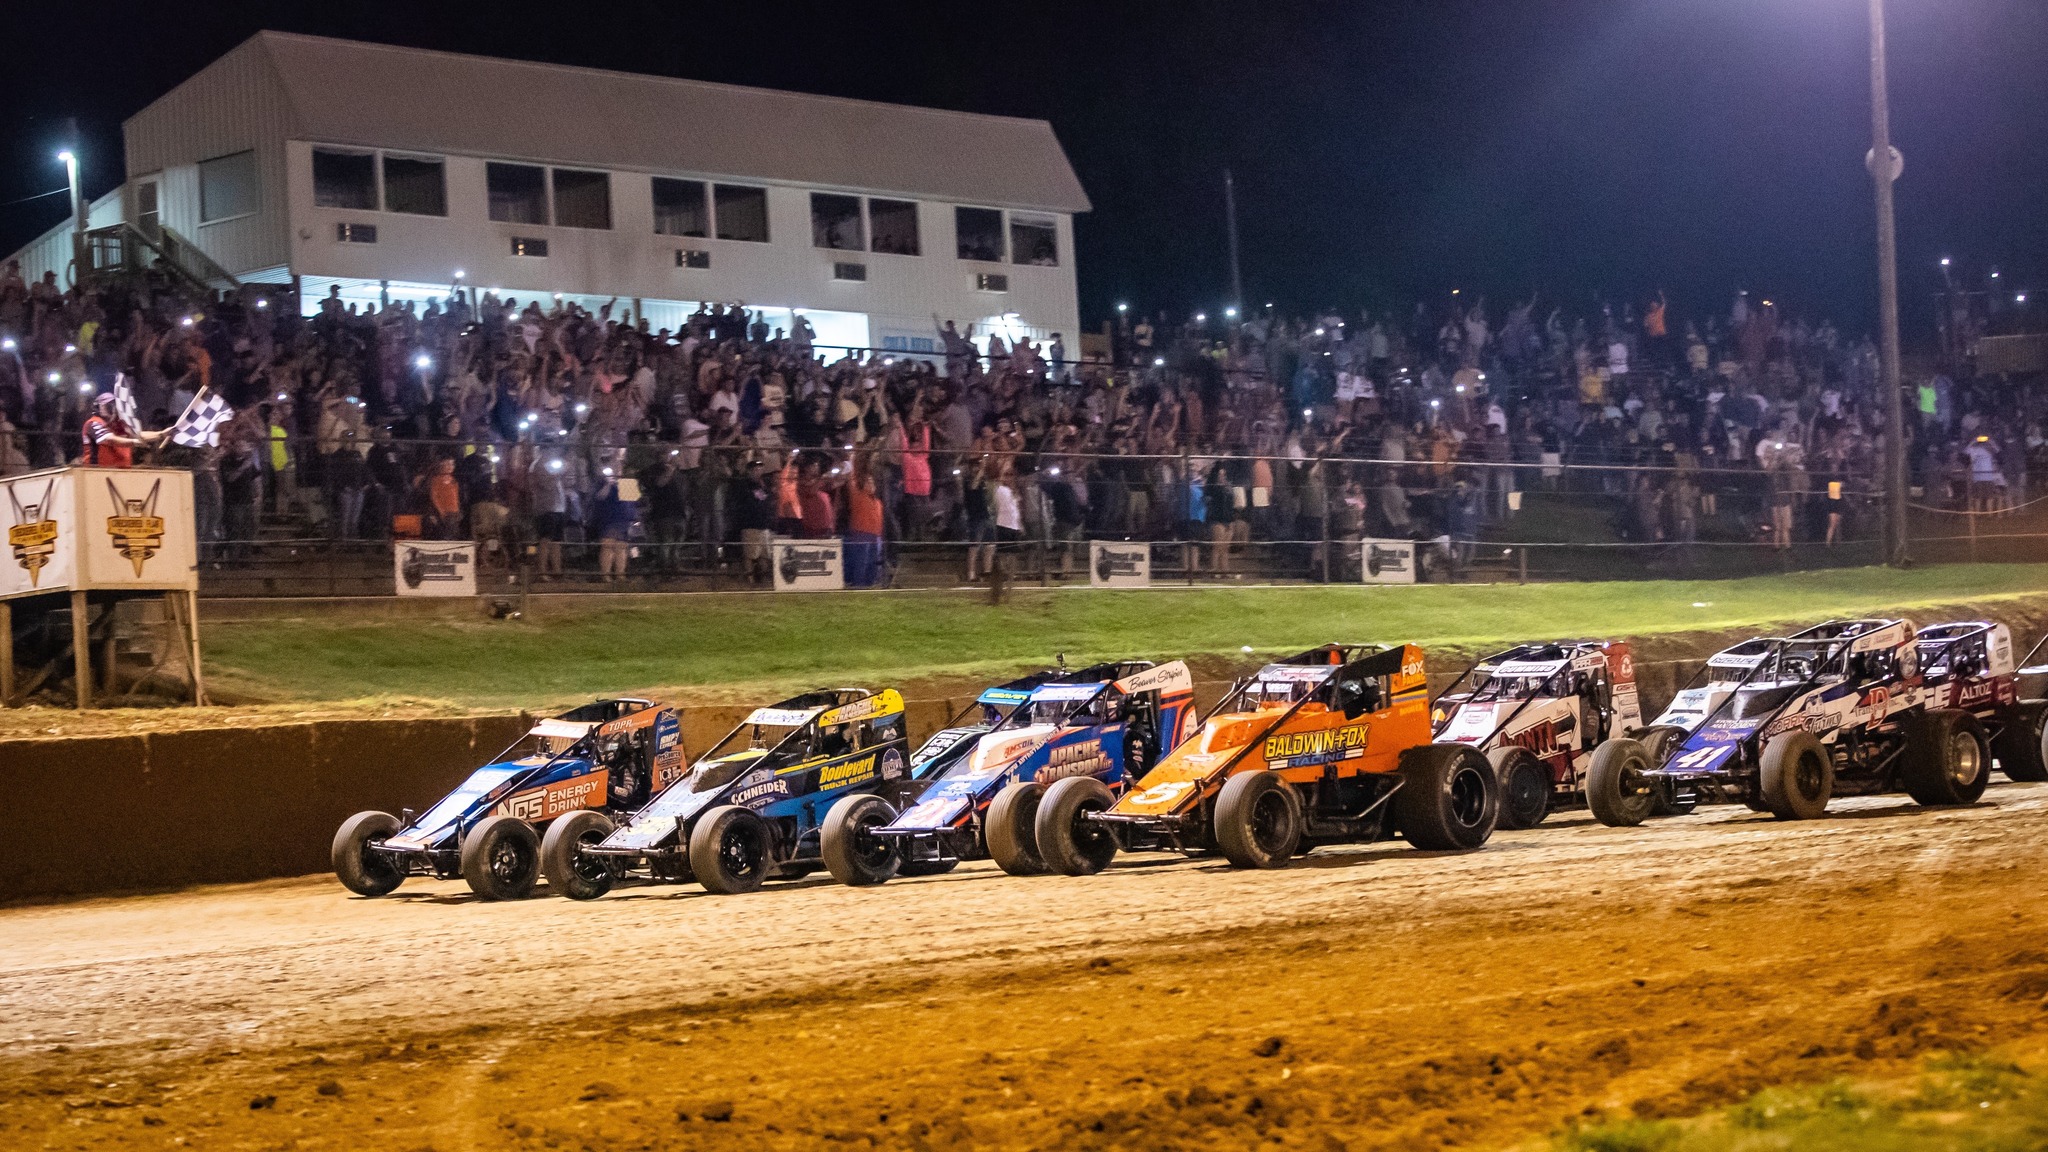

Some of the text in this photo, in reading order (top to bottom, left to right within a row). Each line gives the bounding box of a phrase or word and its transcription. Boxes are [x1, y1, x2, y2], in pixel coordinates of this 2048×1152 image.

[1402, 660, 1424, 678] FOX
[1958, 681, 1992, 705] ALTOZ
[1004, 739, 1034, 757] AMSOIL
[1265, 725, 1369, 758] BALDWIN-FOX
[1049, 740, 1101, 767] APACHE
[1288, 751, 1345, 767] RACING
[1675, 745, 1732, 768] 41
[659, 768, 672, 782] ICS
[820, 752, 877, 784] Boulevard
[1042, 752, 1105, 783] TRANSPORT
[549, 780, 599, 803] ENERGY
[731, 779, 789, 806] SCHNEIDER
[820, 771, 875, 792] TRUCK REPAIR
[497, 788, 548, 819] NOS
[548, 795, 587, 814] DRINK
